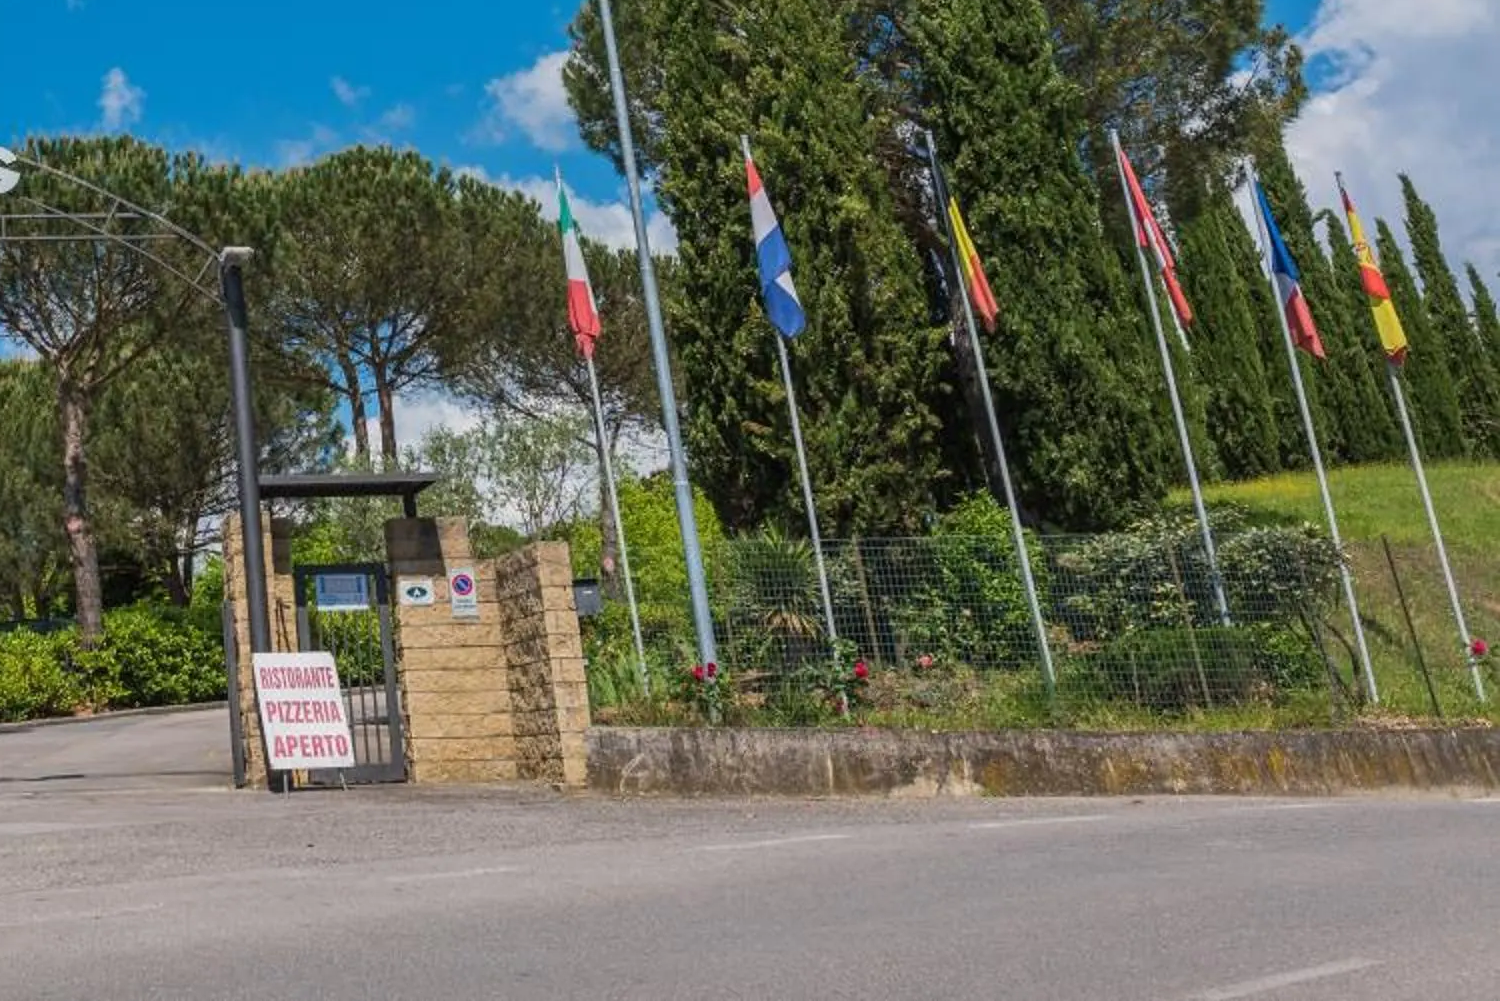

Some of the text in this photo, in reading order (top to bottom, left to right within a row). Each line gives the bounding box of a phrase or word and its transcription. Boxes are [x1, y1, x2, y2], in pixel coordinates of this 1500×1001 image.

[259, 666, 335, 690] RISTORANTE
[266, 699, 342, 724] PIZZERIA
[274, 734, 349, 758] APERTO
